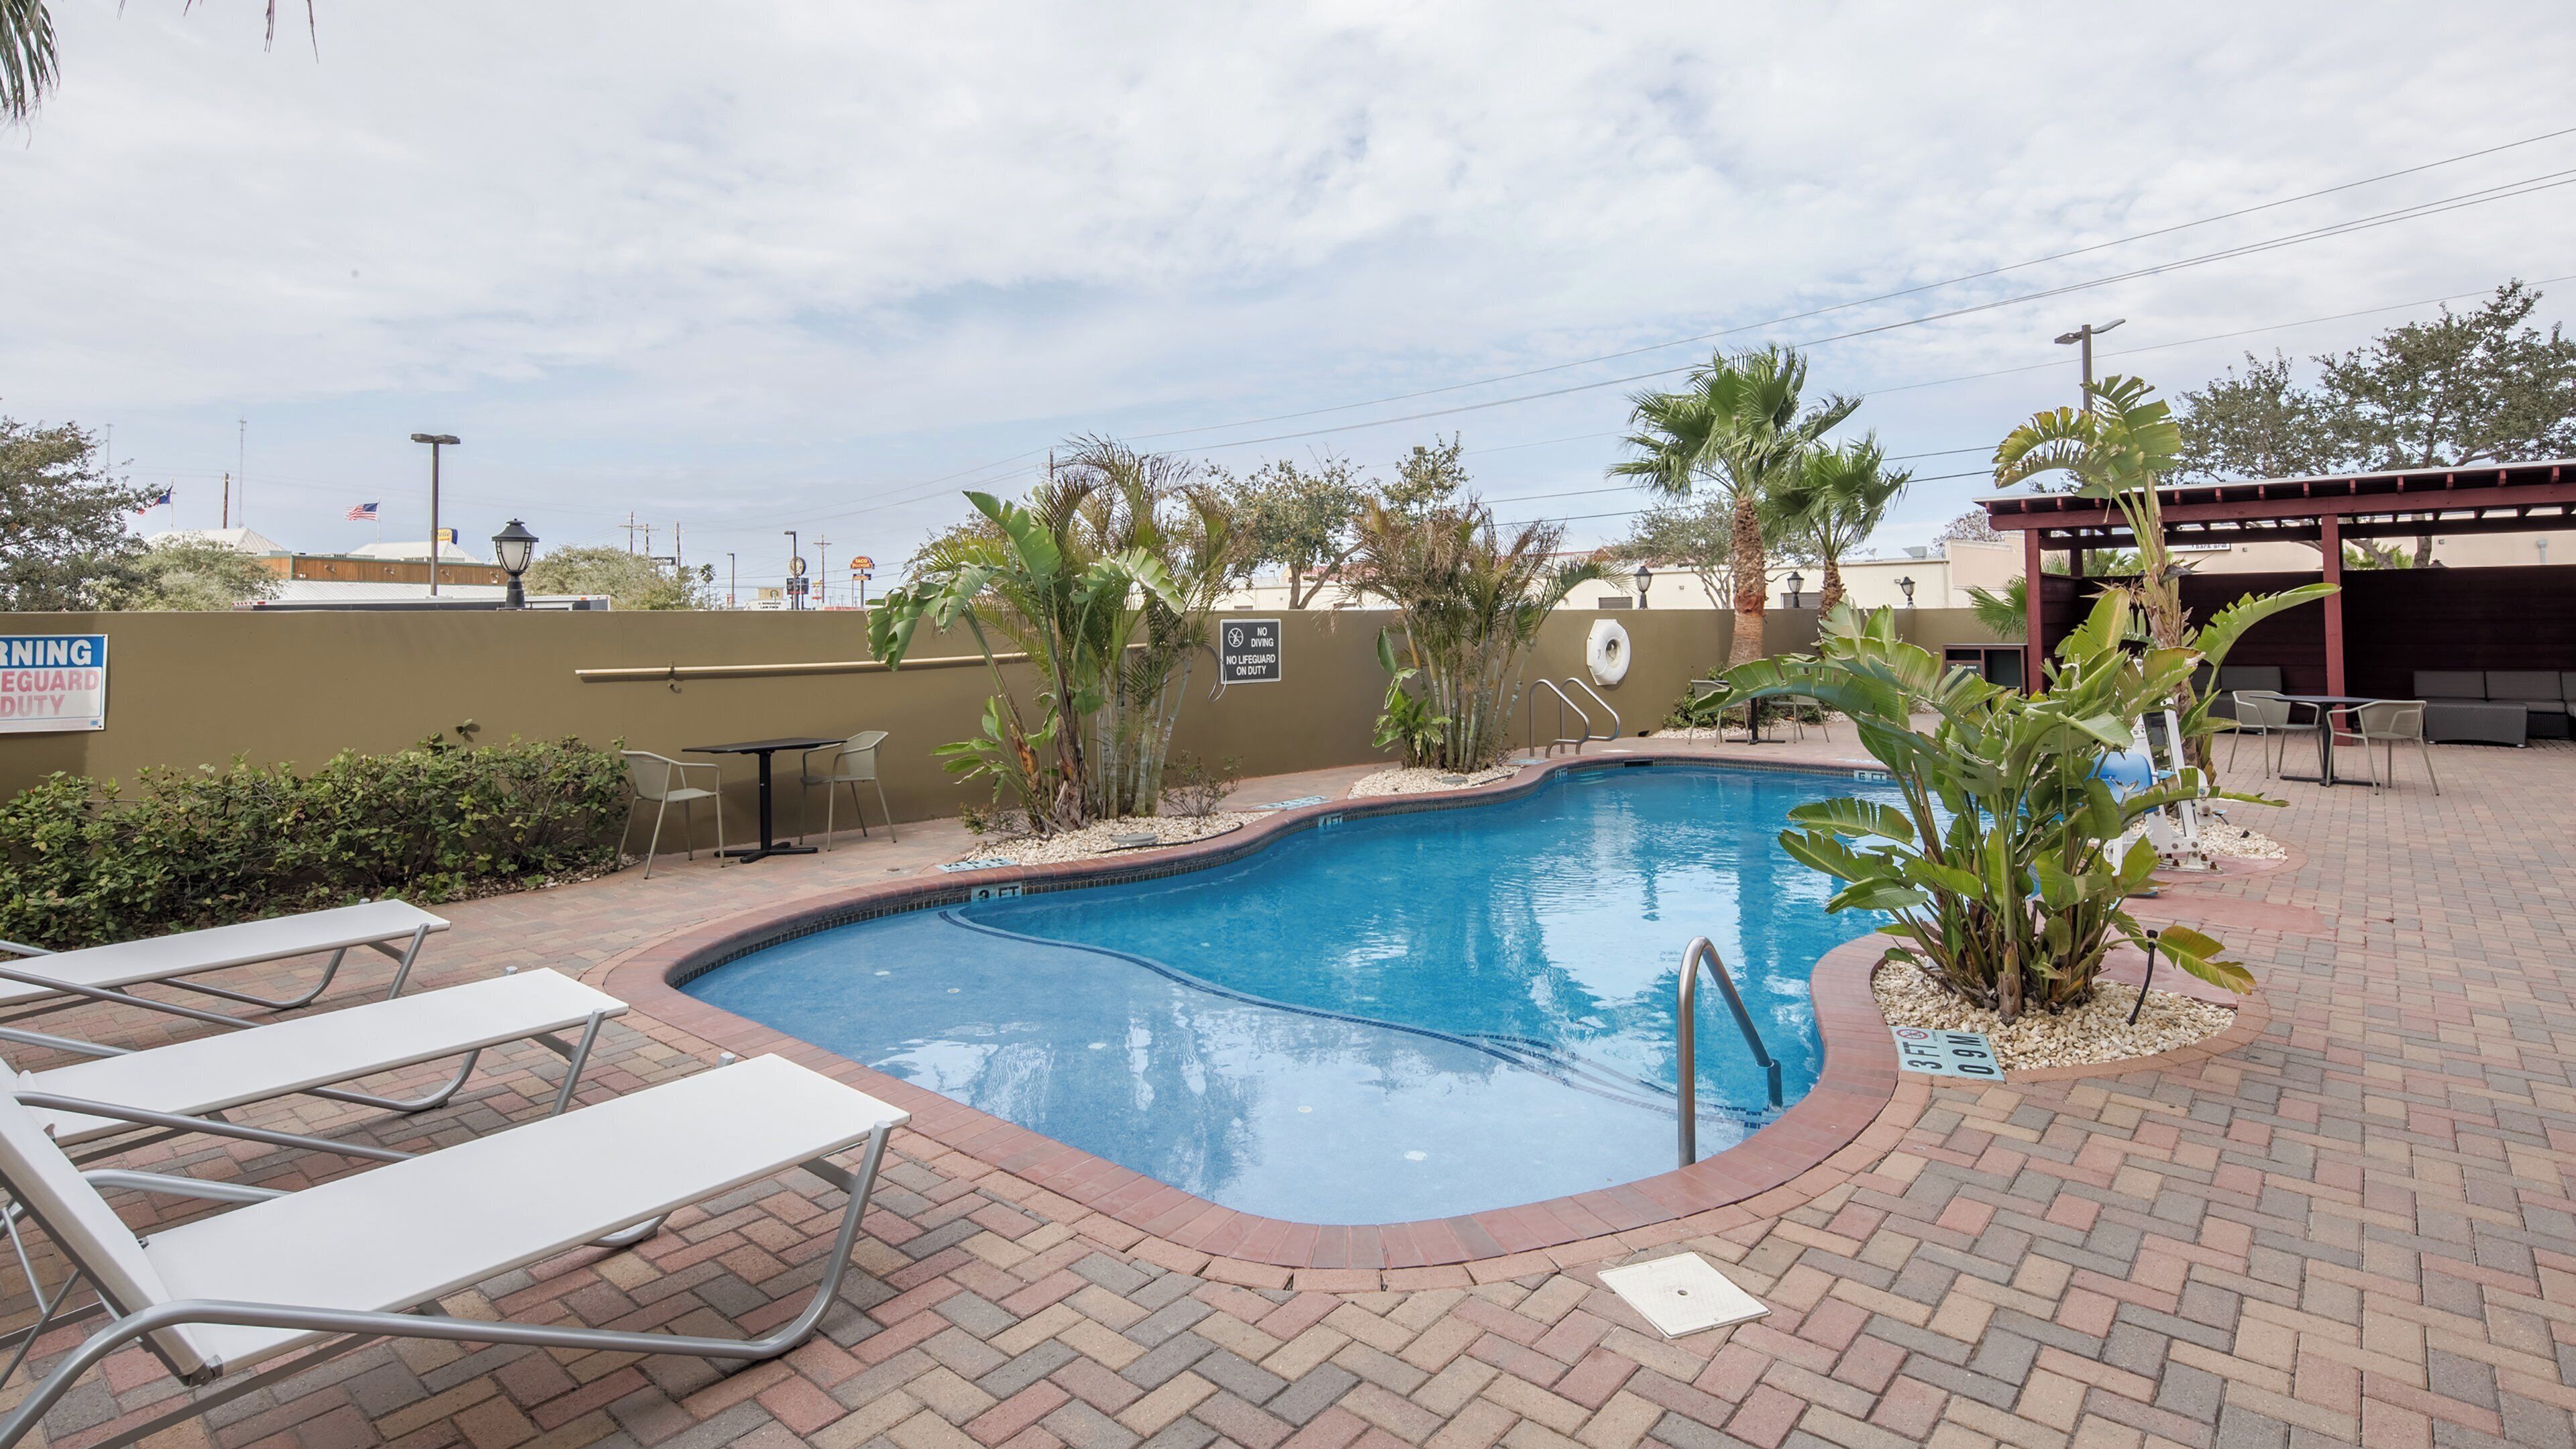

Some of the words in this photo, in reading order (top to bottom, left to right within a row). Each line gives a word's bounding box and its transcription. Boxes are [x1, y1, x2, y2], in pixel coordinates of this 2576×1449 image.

[1257, 627, 1267, 637] NO
[1251, 638, 1274, 647] DIVING
[1226, 655, 1237, 665] NO
[1238, 654, 1276, 664] LIFEGUARD
[1236, 666, 1246, 676] ON
[1248, 665, 1267, 675] DUTY
[1, 694, 65, 717] DUTY
[1945, 1034, 1982, 1046] M
[1902, 1041, 1941, 1057] FT
[1907, 1059, 1943, 1069] 3
